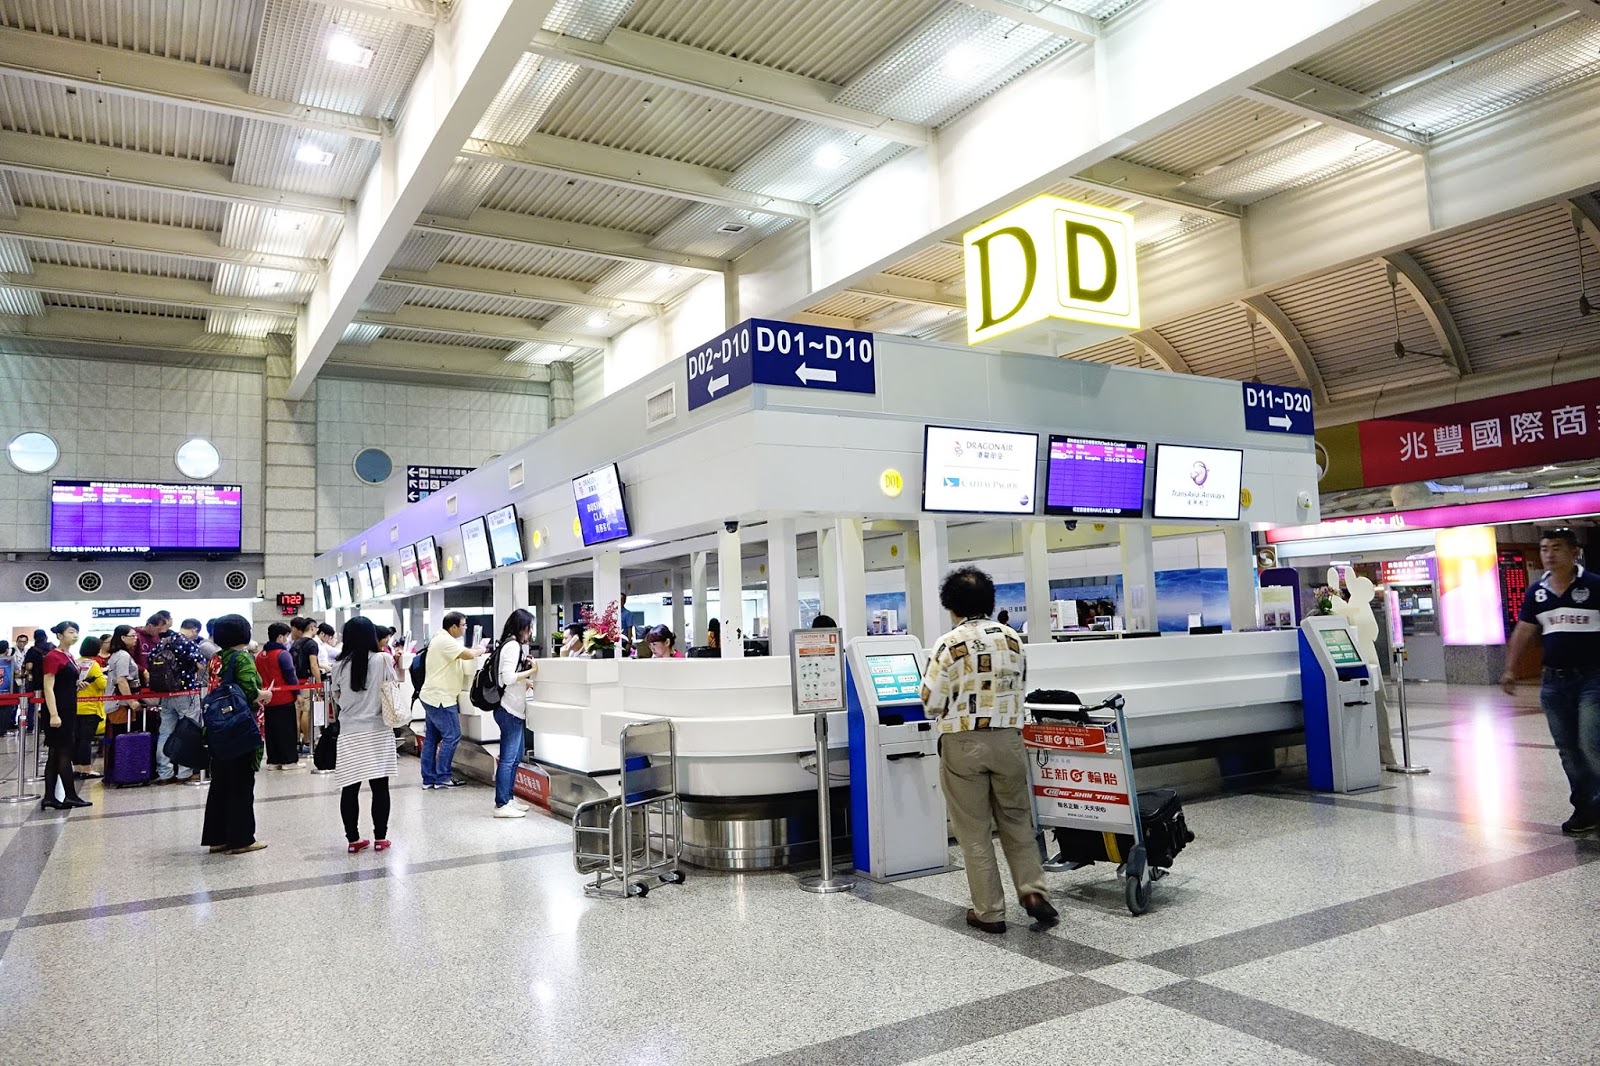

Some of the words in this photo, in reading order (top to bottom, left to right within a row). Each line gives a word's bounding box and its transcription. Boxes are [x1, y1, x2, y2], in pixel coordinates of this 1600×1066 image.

[1065, 219, 1117, 303] D
[971, 226, 1037, 333] D
[688, 328, 750, 381] D02~D10
[756, 326, 873, 364] D01~D10
[1246, 387, 1311, 413] D11~D20
[1399, 403, 1600, 462] 兆豐國際商
[966, 441, 1014, 452] DRAGONAIR
[1201, 491, 1226, 500] Airways
[281, 595, 302, 604] 17:22
[1534, 588, 1548, 603] 8
[1040, 767, 1069, 781] 正新
[1087, 770, 1118, 786] 輪胎
[1071, 791, 1094, 799] SHIN
[1094, 793, 1120, 802] TIRE
